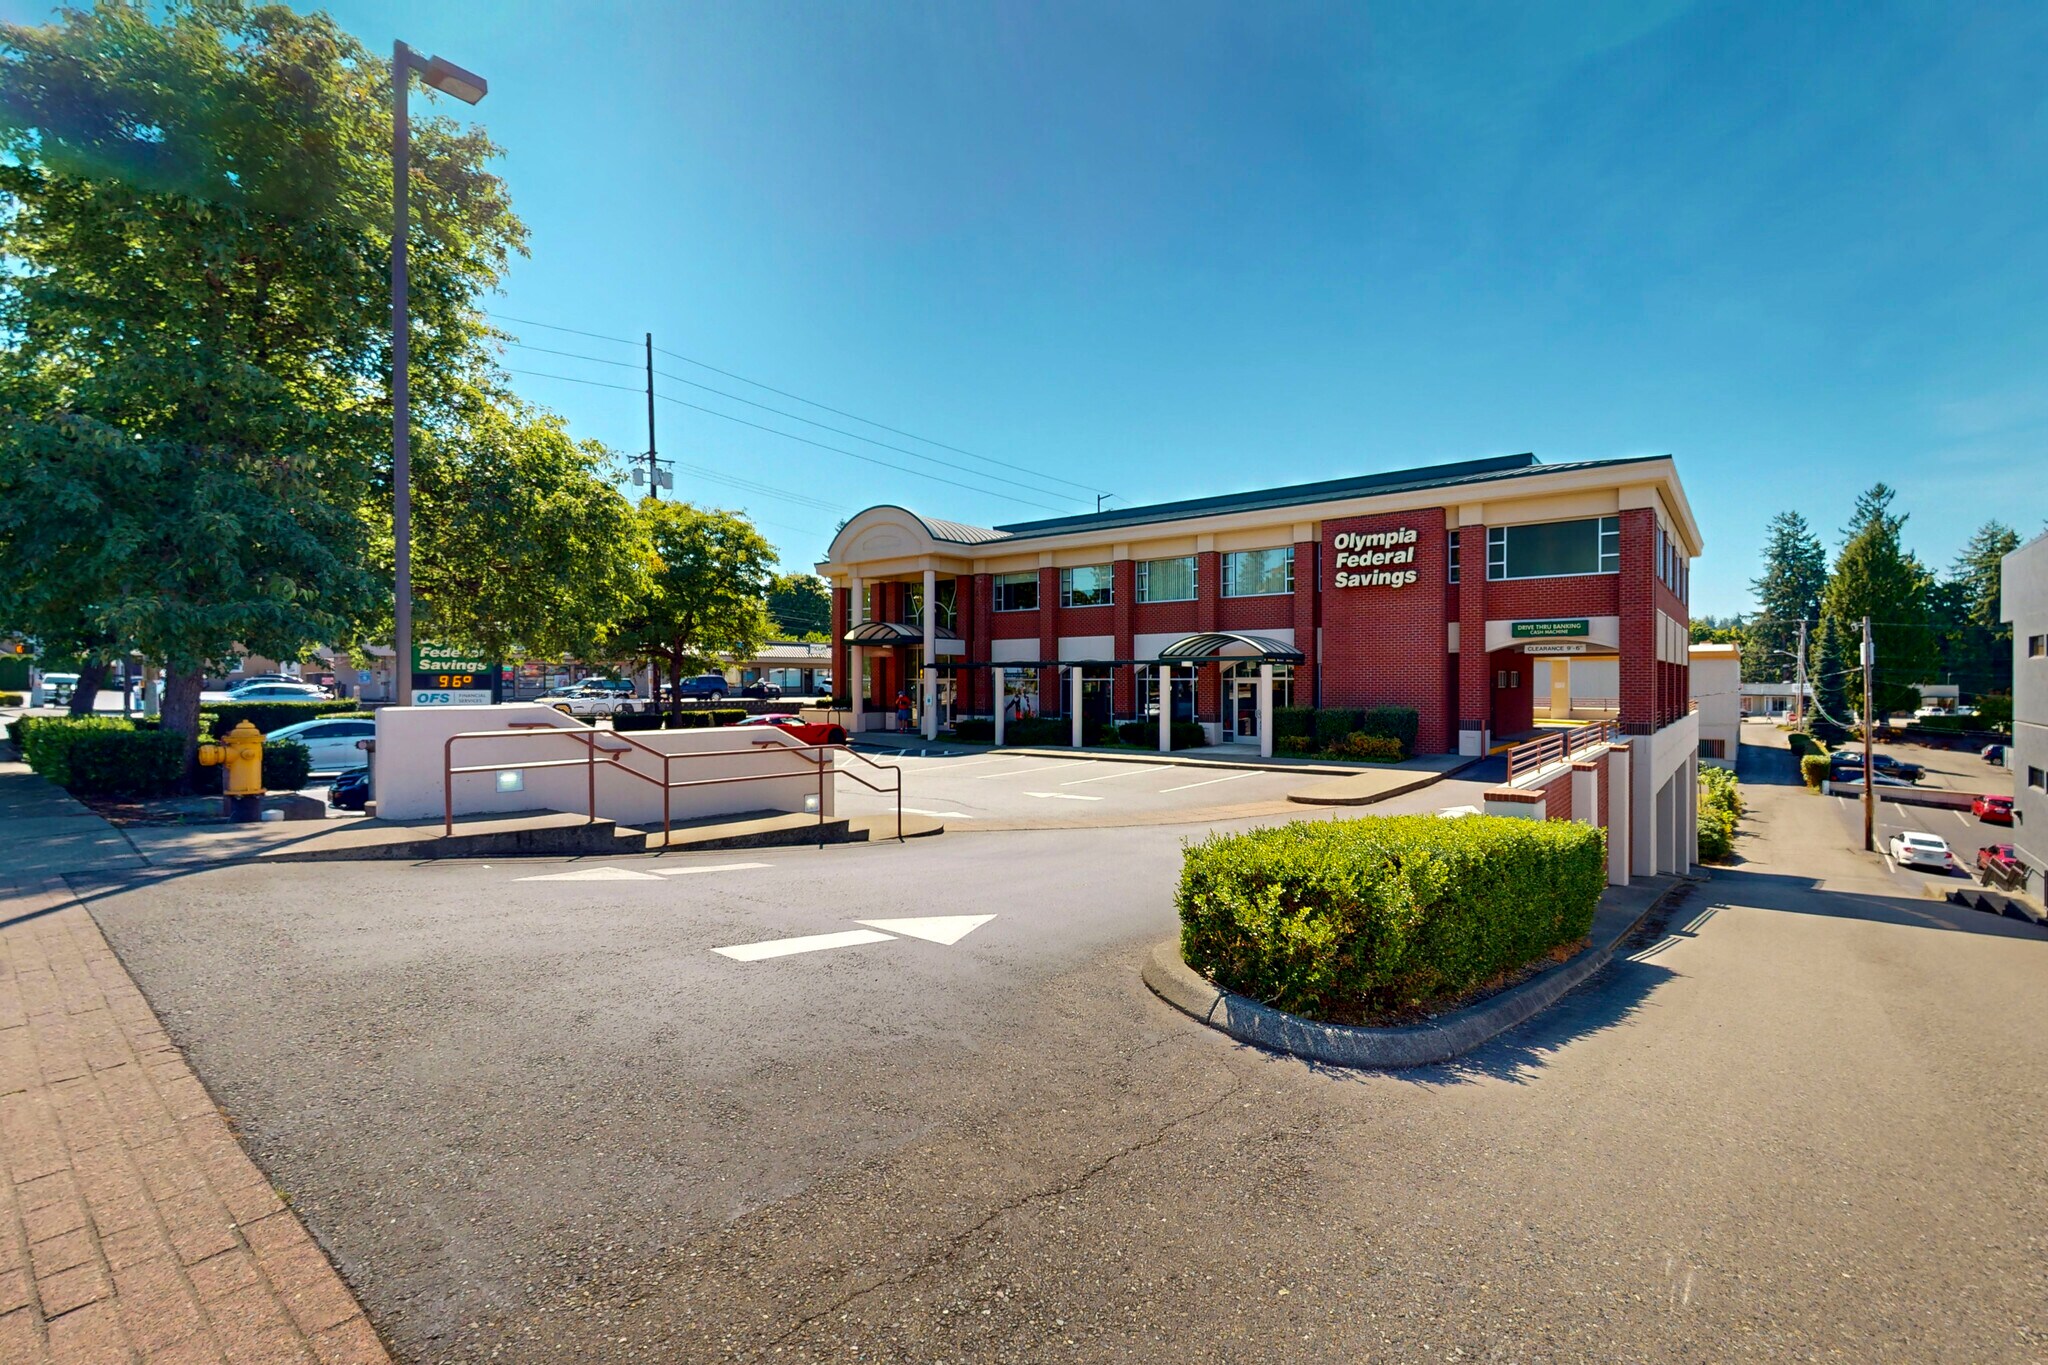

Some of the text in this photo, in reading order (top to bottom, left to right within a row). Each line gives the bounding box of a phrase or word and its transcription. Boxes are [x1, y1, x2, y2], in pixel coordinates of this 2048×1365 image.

[1334, 527, 1417, 551] Olympia
[1335, 546, 1415, 569] Federal
[1334, 569, 1417, 588] Savings
[419, 659, 487, 672] Savings
[417, 693, 450, 704] OFS
